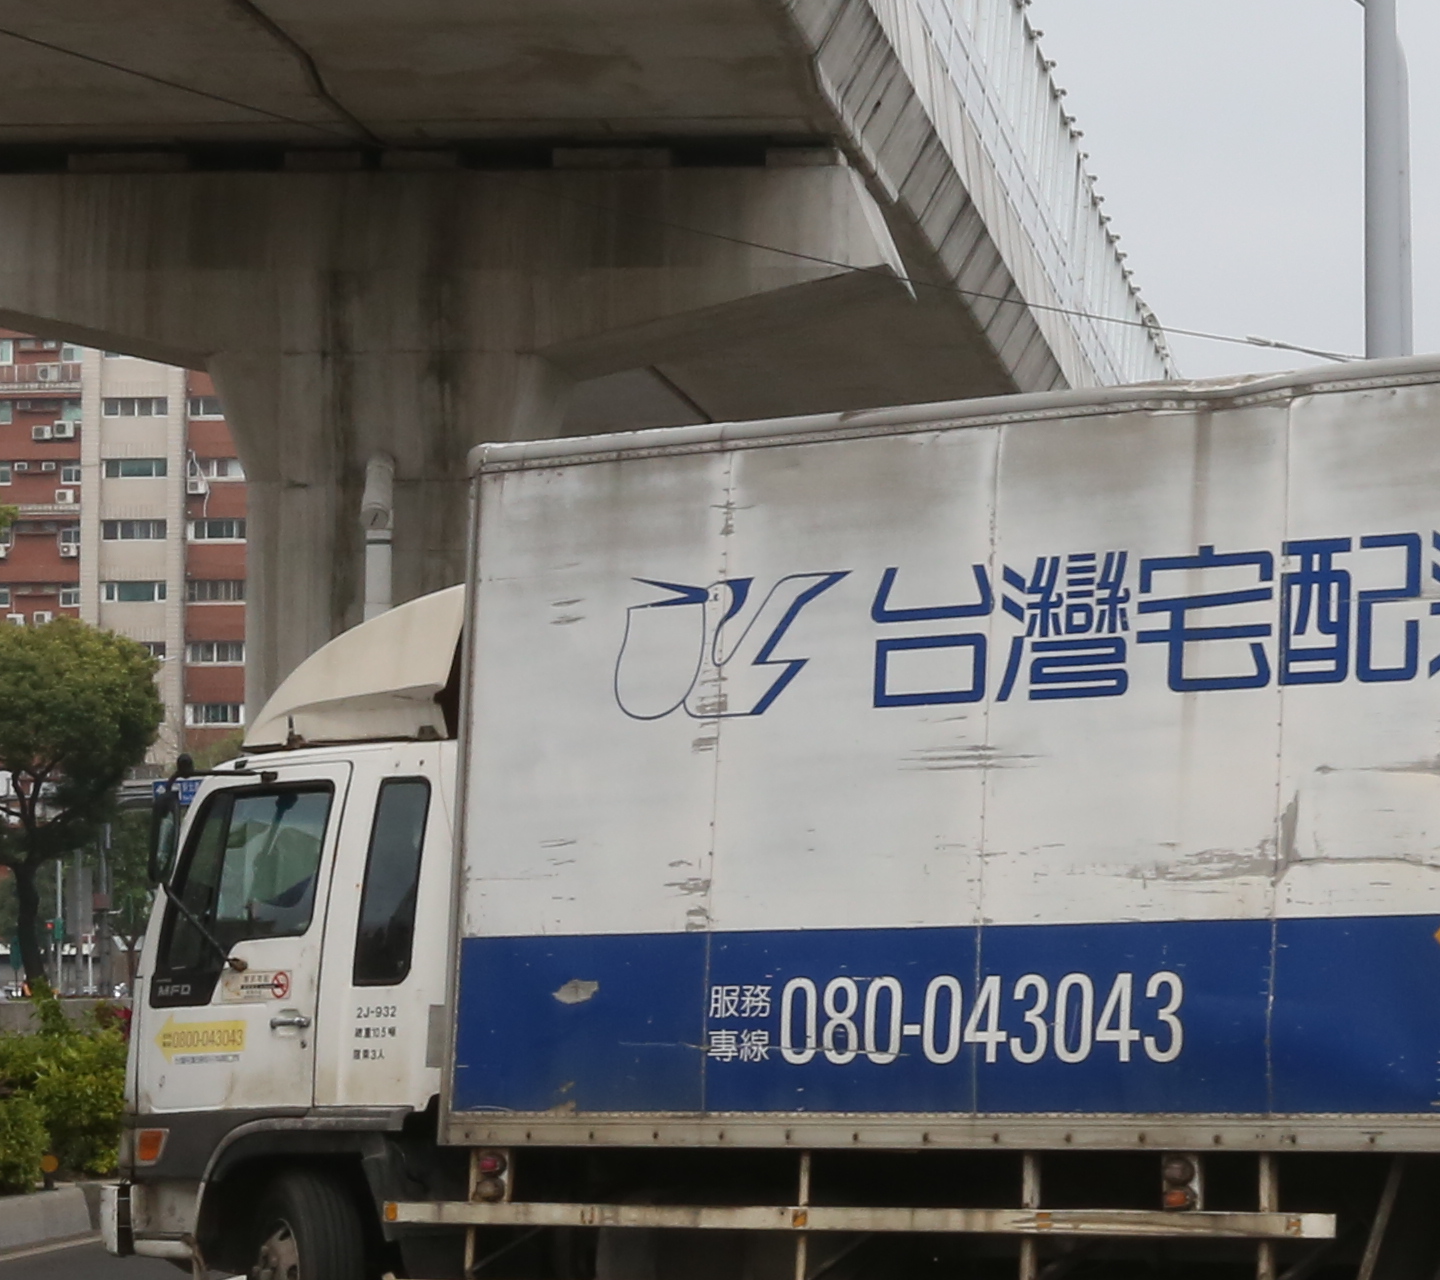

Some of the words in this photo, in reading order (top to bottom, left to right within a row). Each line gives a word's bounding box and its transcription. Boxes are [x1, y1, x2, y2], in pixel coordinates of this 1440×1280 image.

[356, 1006, 397, 1019] 2J-932
[709, 985, 771, 1019] 服務
[780, 970, 1184, 1065] 080-043043
[172, 1029, 243, 1049] 0800-043043
[708, 1028, 770, 1062] 專線
